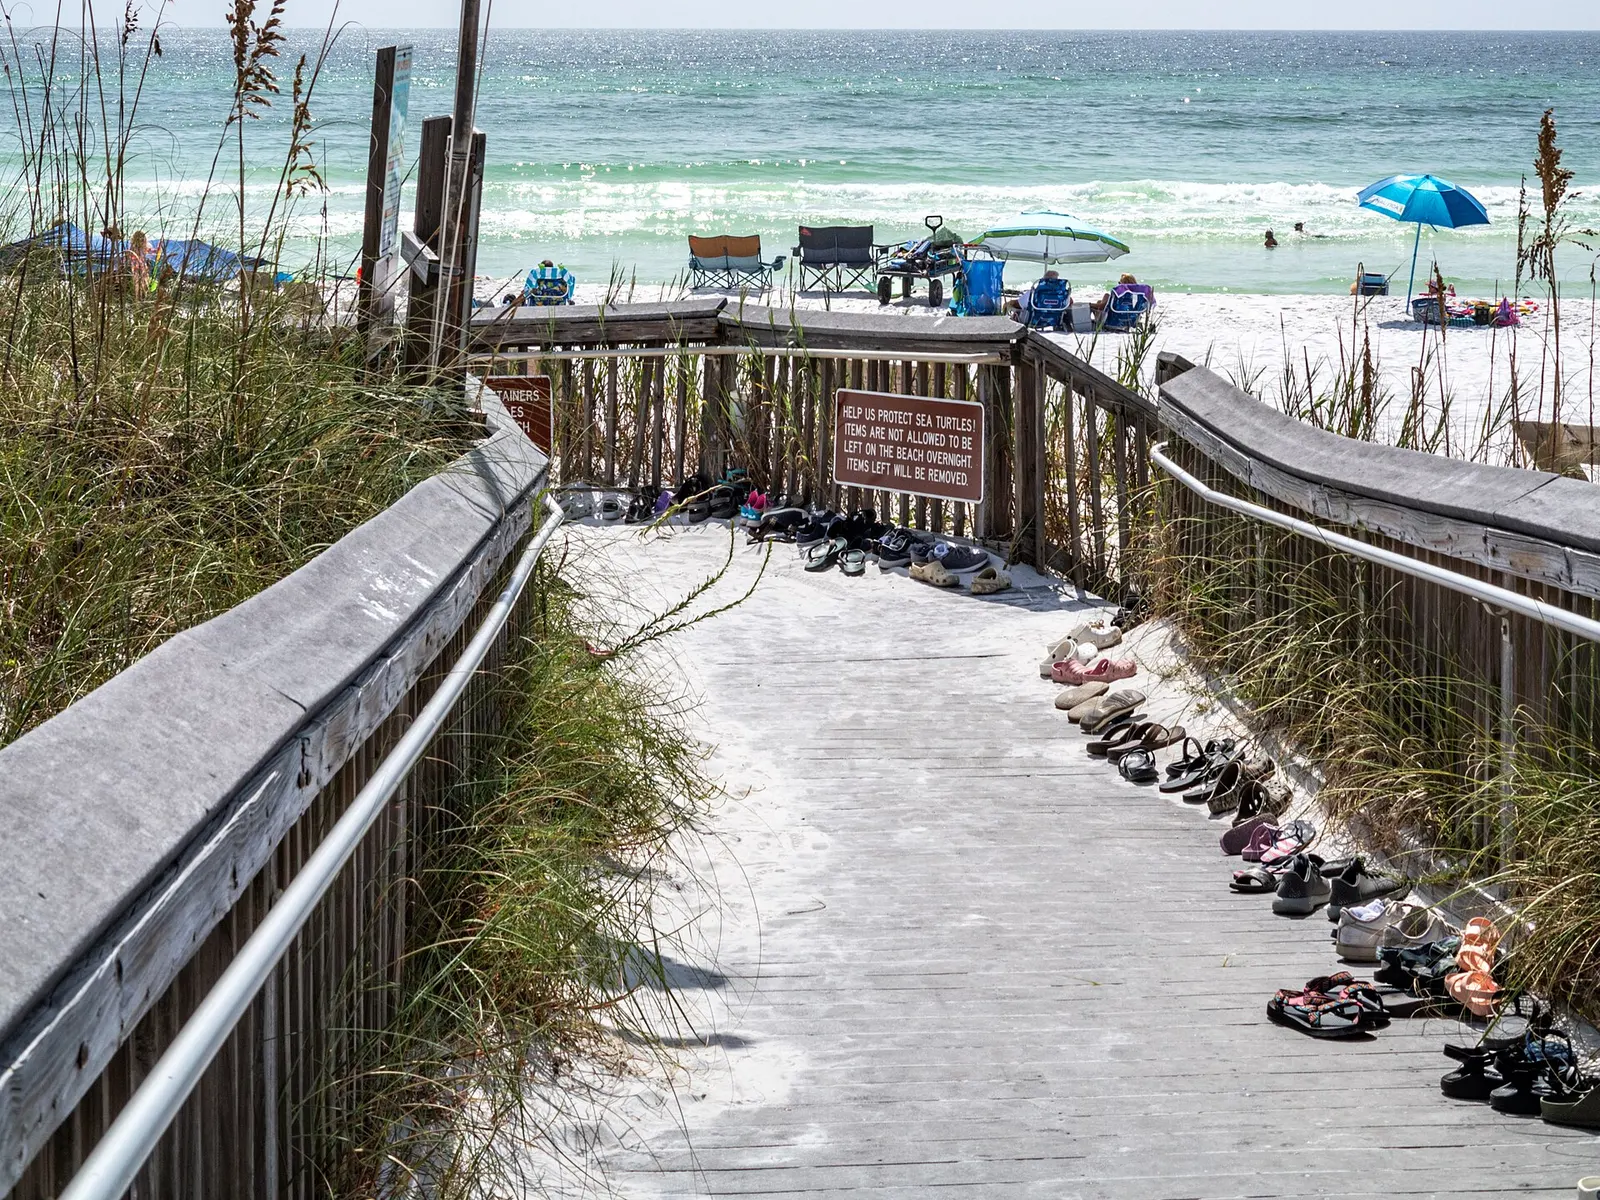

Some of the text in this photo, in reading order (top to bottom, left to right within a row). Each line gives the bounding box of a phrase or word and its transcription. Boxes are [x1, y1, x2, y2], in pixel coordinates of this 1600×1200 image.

[494, 390, 540, 402] TAINERS
[843, 405, 976, 432] HELP US PROTECT SEA TURTLES!
[845, 422, 972, 450] ITEMS ARE NOT ALLOWED TO BE
[844, 440, 972, 469] LEFT ON THE BEACH OVERNIGHT.
[847, 457, 968, 486] ITEMS LEFT WILL BE REMOVED.
